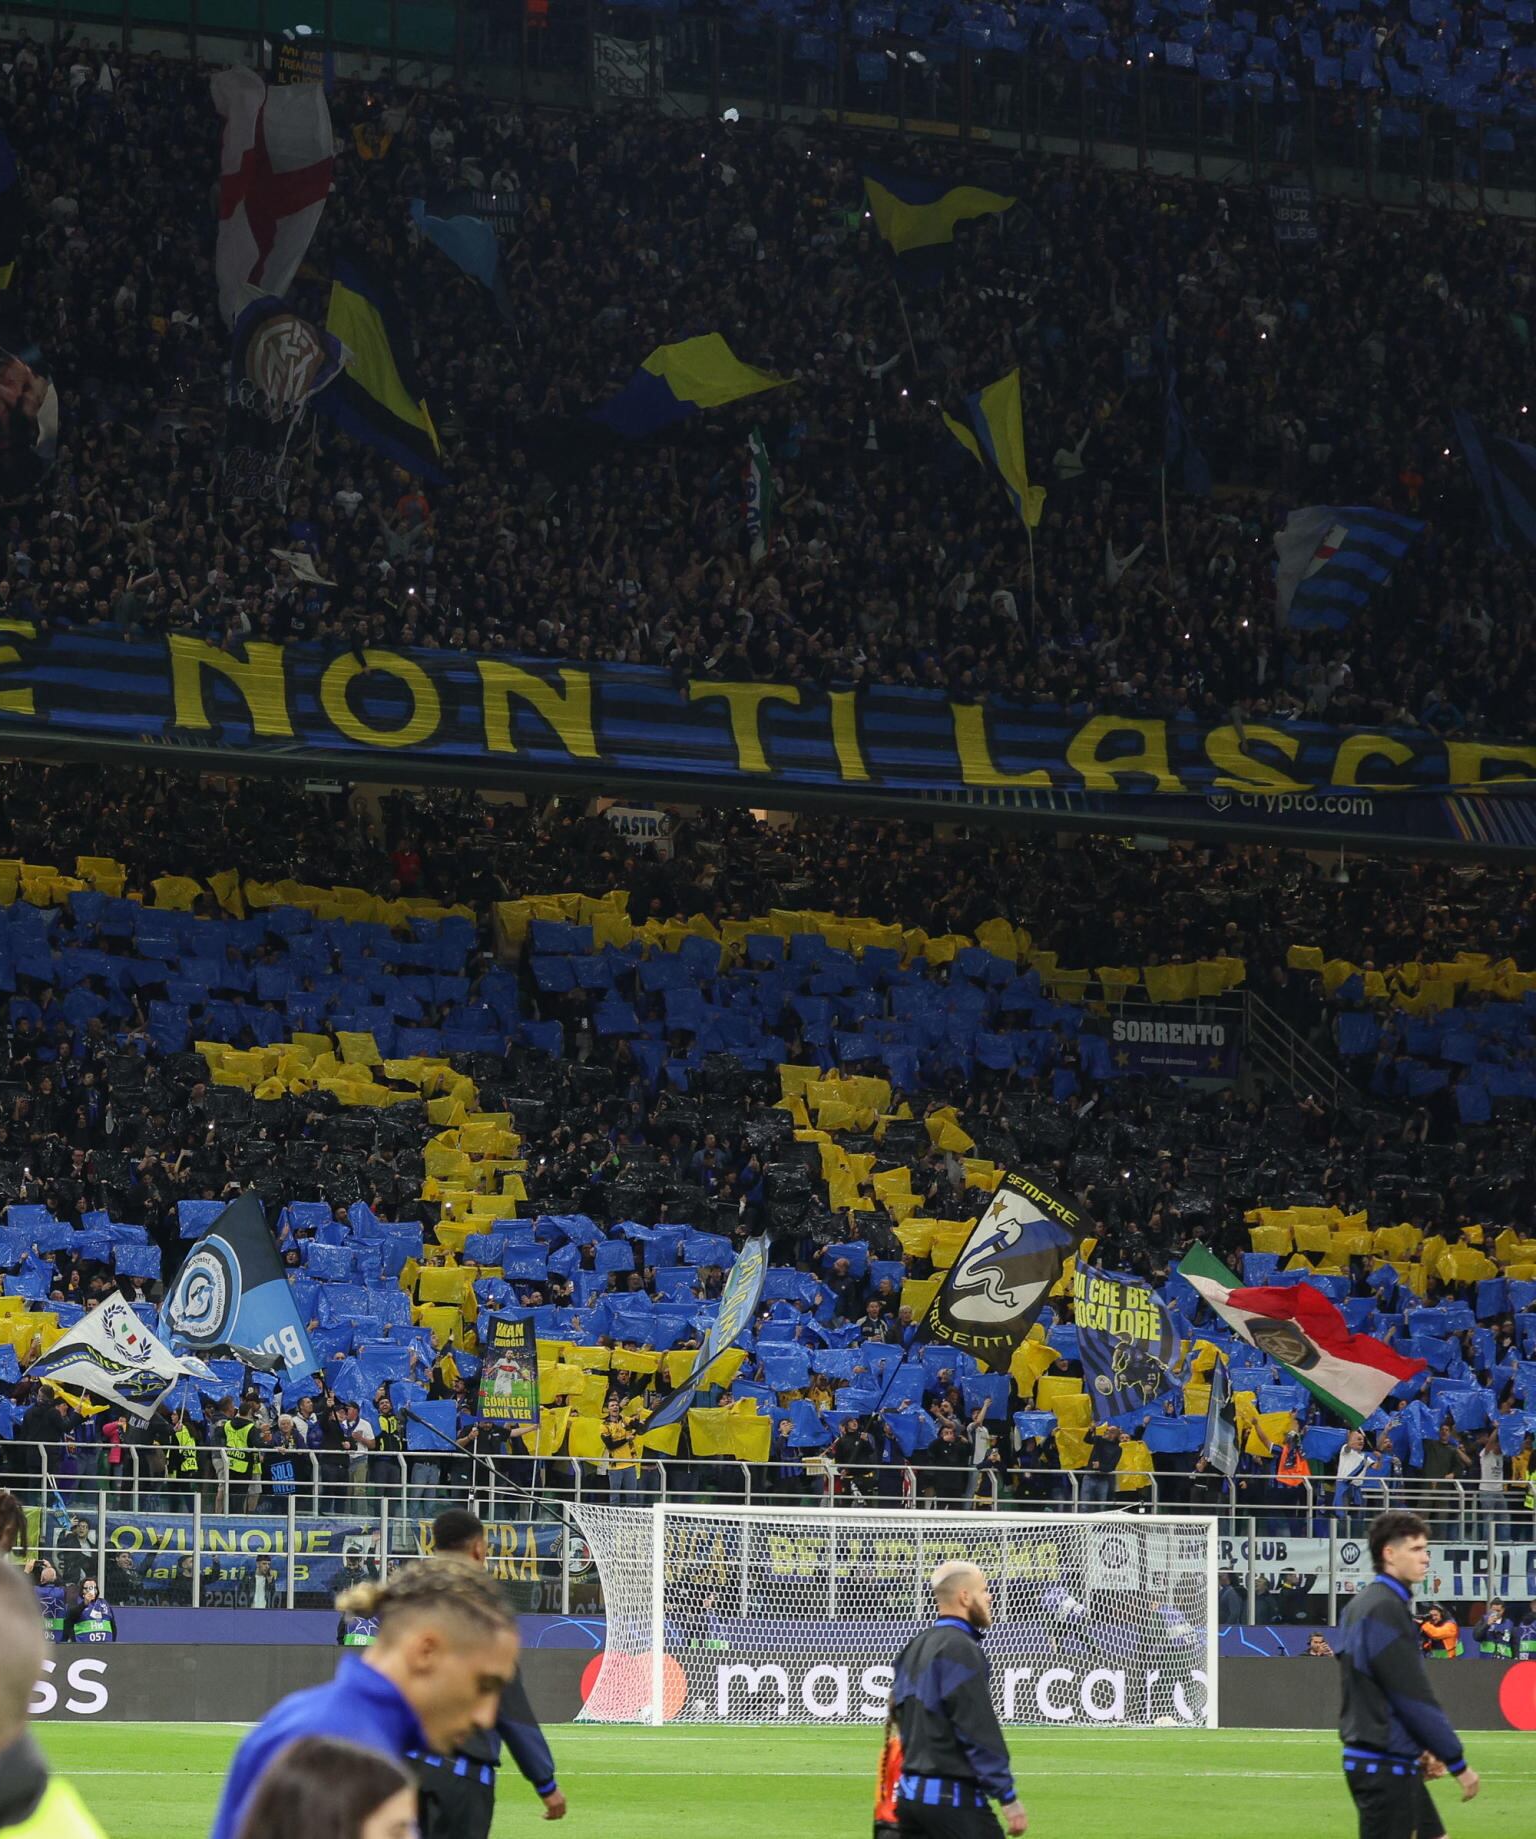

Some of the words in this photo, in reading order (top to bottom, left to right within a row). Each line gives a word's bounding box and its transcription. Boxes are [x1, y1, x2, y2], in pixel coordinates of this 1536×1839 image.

[167, 631, 601, 758] NON
[688, 678, 871, 781] TI
[1240, 793, 1375, 816] crypto.com
[611, 815, 664, 837] CASTR
[1112, 1019, 1225, 1047] SORRENTO
[1006, 1172, 1080, 1228] SEMPRE
[1088, 1279, 1121, 1306] CHE
[270, 1461, 294, 1479] SOLO
[110, 1525, 333, 1555] OVUNQUE
[1241, 1540, 1289, 1562] CLUB
[89, 1632, 106, 1642] 057
[717, 1663, 1207, 1722] masrcar
